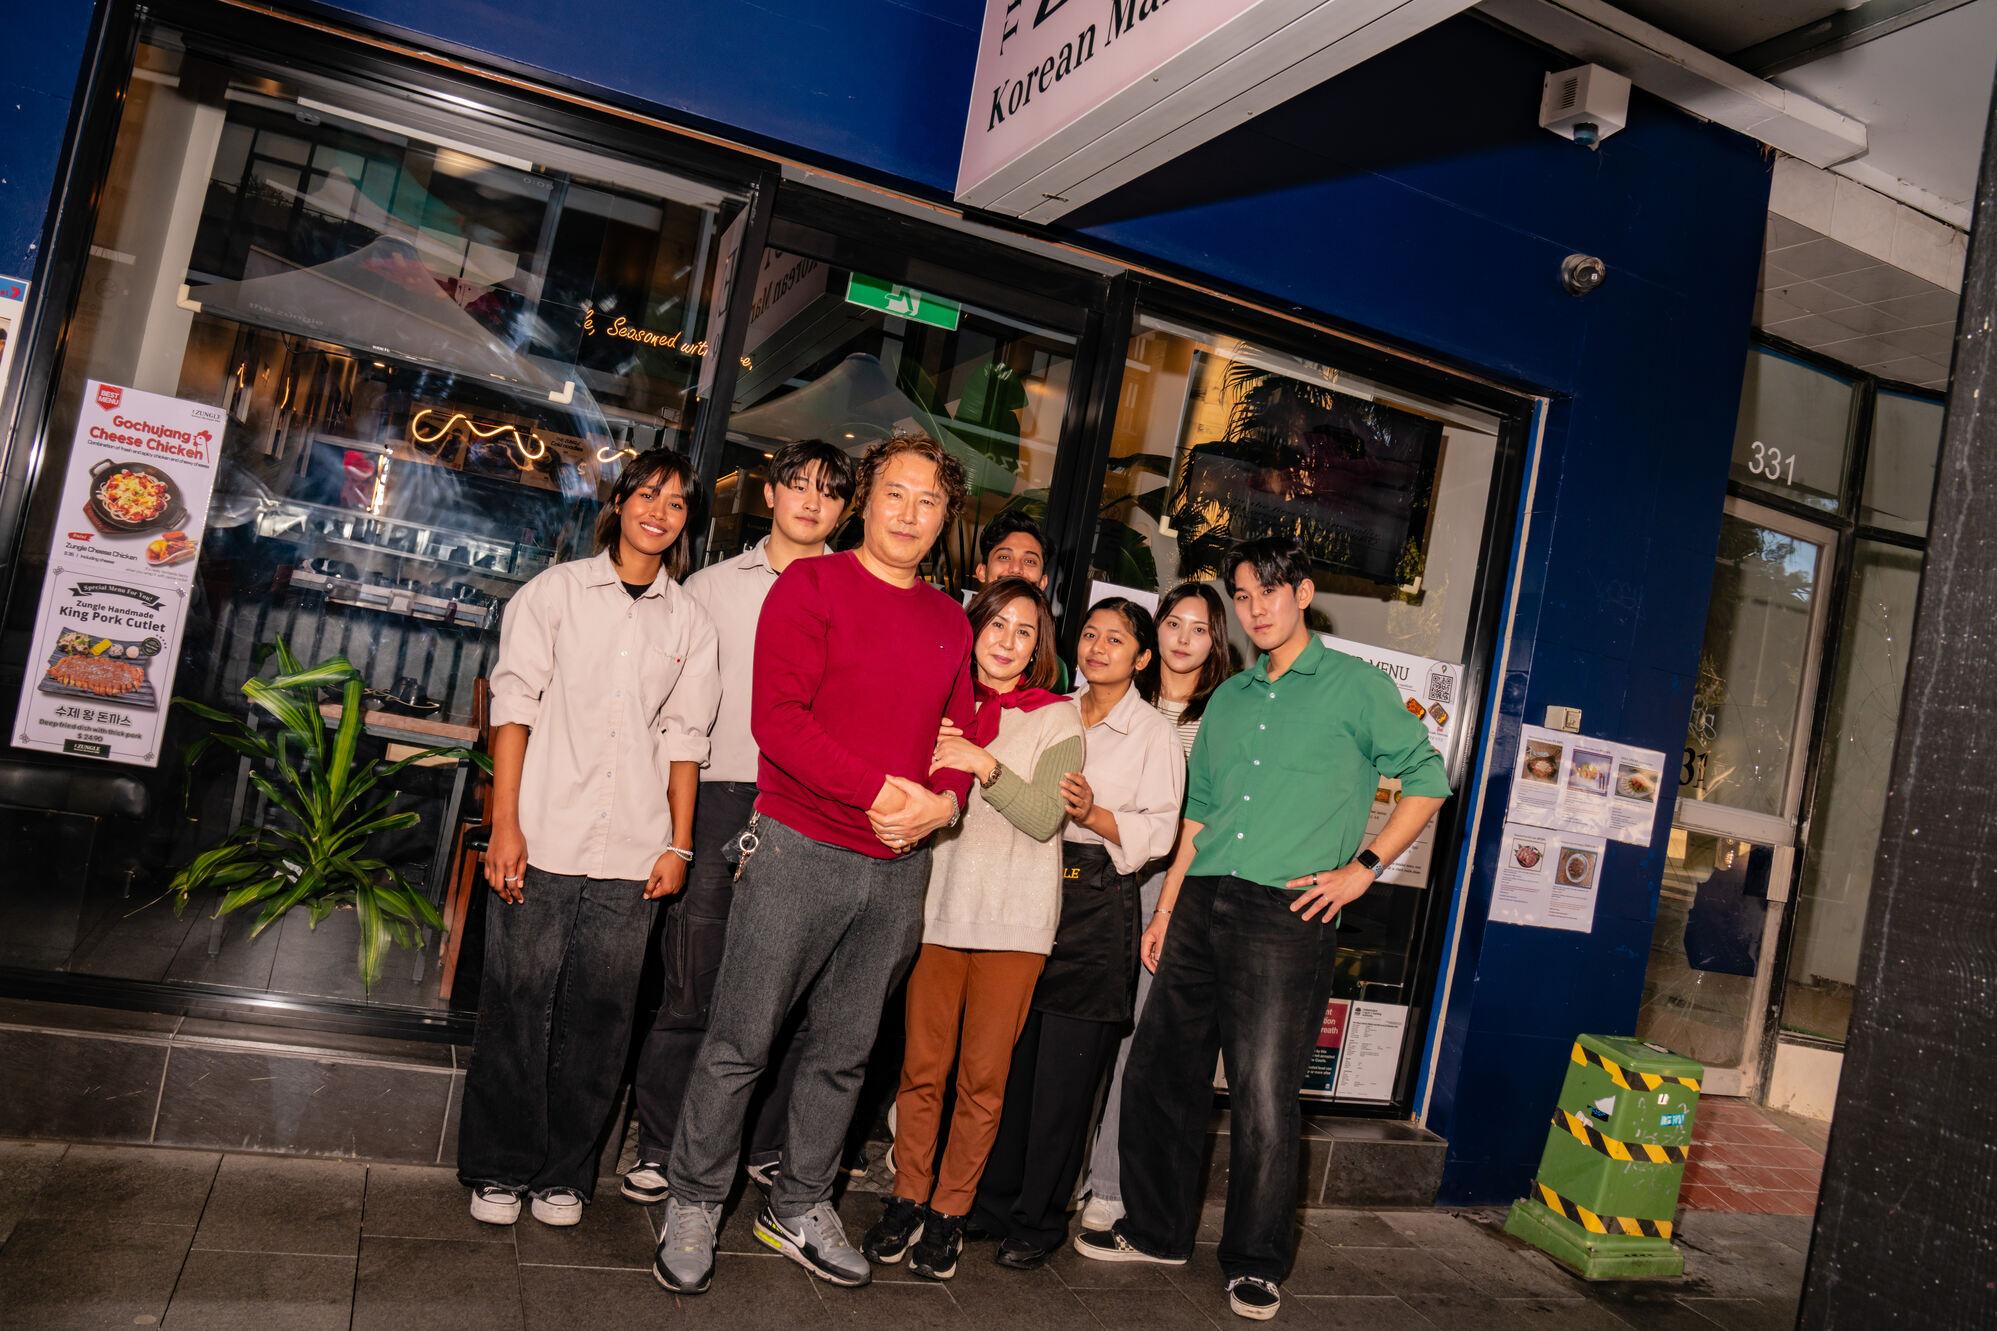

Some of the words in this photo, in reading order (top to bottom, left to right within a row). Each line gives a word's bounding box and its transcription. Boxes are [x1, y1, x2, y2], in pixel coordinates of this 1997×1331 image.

[987, 24, 1096, 132] Korean
[1104, 0, 1169, 47] Ma
[607, 316, 682, 348] Seasoned
[98, 395, 119, 406] MENU
[101, 390, 119, 399] BEST
[113, 415, 191, 444] Gochujang
[89, 426, 143, 447] Cheese
[146, 438, 204, 460] Chicken
[1748, 441, 1796, 486] 331
[66, 542, 87, 552] Zungle
[88, 546, 112, 556] Cheese
[112, 551, 138, 561] Chicken
[126, 589, 138, 597] For
[139, 592, 153, 601] You!
[59, 606, 89, 622] King
[92, 611, 122, 625] Pork
[126, 617, 166, 633] Cutlet
[76, 600, 106, 611] Zungle
[108, 605, 154, 619] Handmade
[55, 705, 80, 719] 수제
[82, 709, 95, 721] 왕
[98, 711, 132, 727] 돈까스
[39, 719, 60, 728] Deep
[60, 721, 76, 730] fried
[77, 724, 92, 732] dish
[125, 731, 142, 739] pork
[1320, 1026, 1339, 1034] reath
